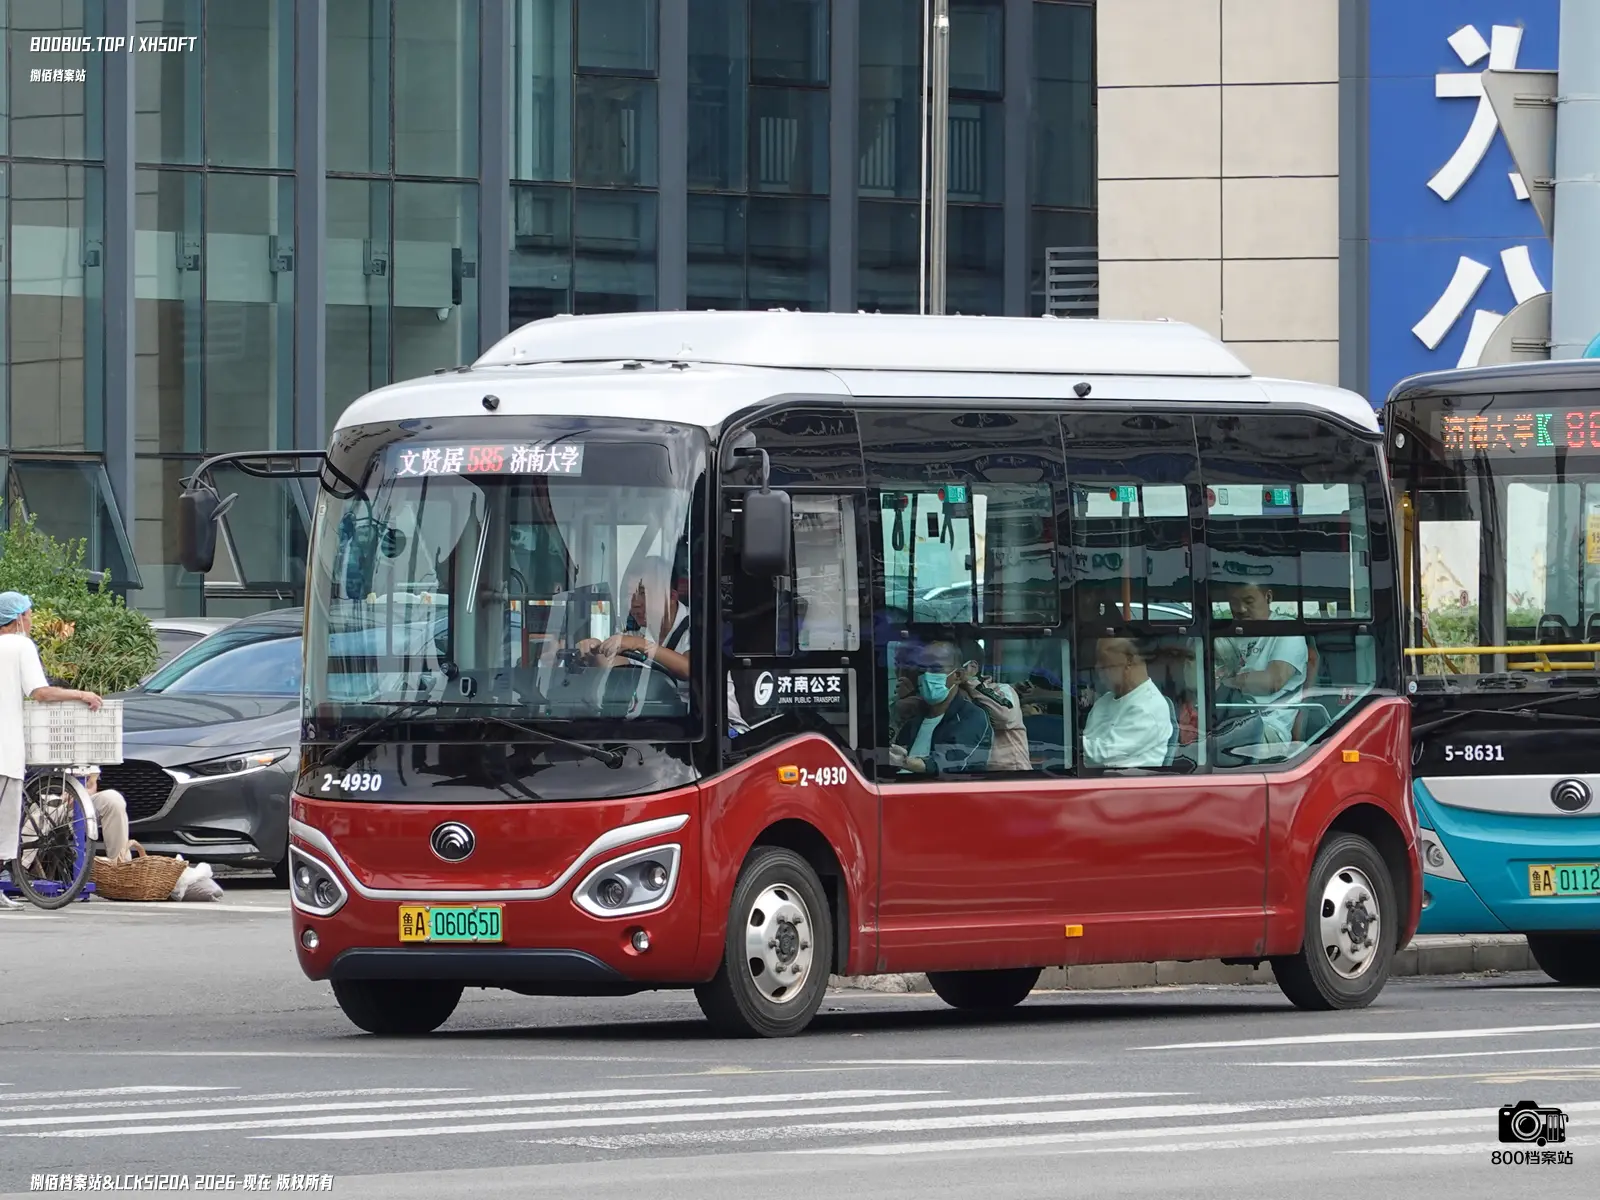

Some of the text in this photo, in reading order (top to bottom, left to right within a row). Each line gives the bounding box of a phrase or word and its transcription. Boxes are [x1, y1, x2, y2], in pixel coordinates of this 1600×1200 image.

[397, 446, 580, 476] 文贤居 585 济南大学
[778, 676, 841, 693] 济南公交
[1445, 744, 1505, 761] 5-8631
[321, 774, 382, 792] 2-4930
[800, 767, 847, 787] 2-4930
